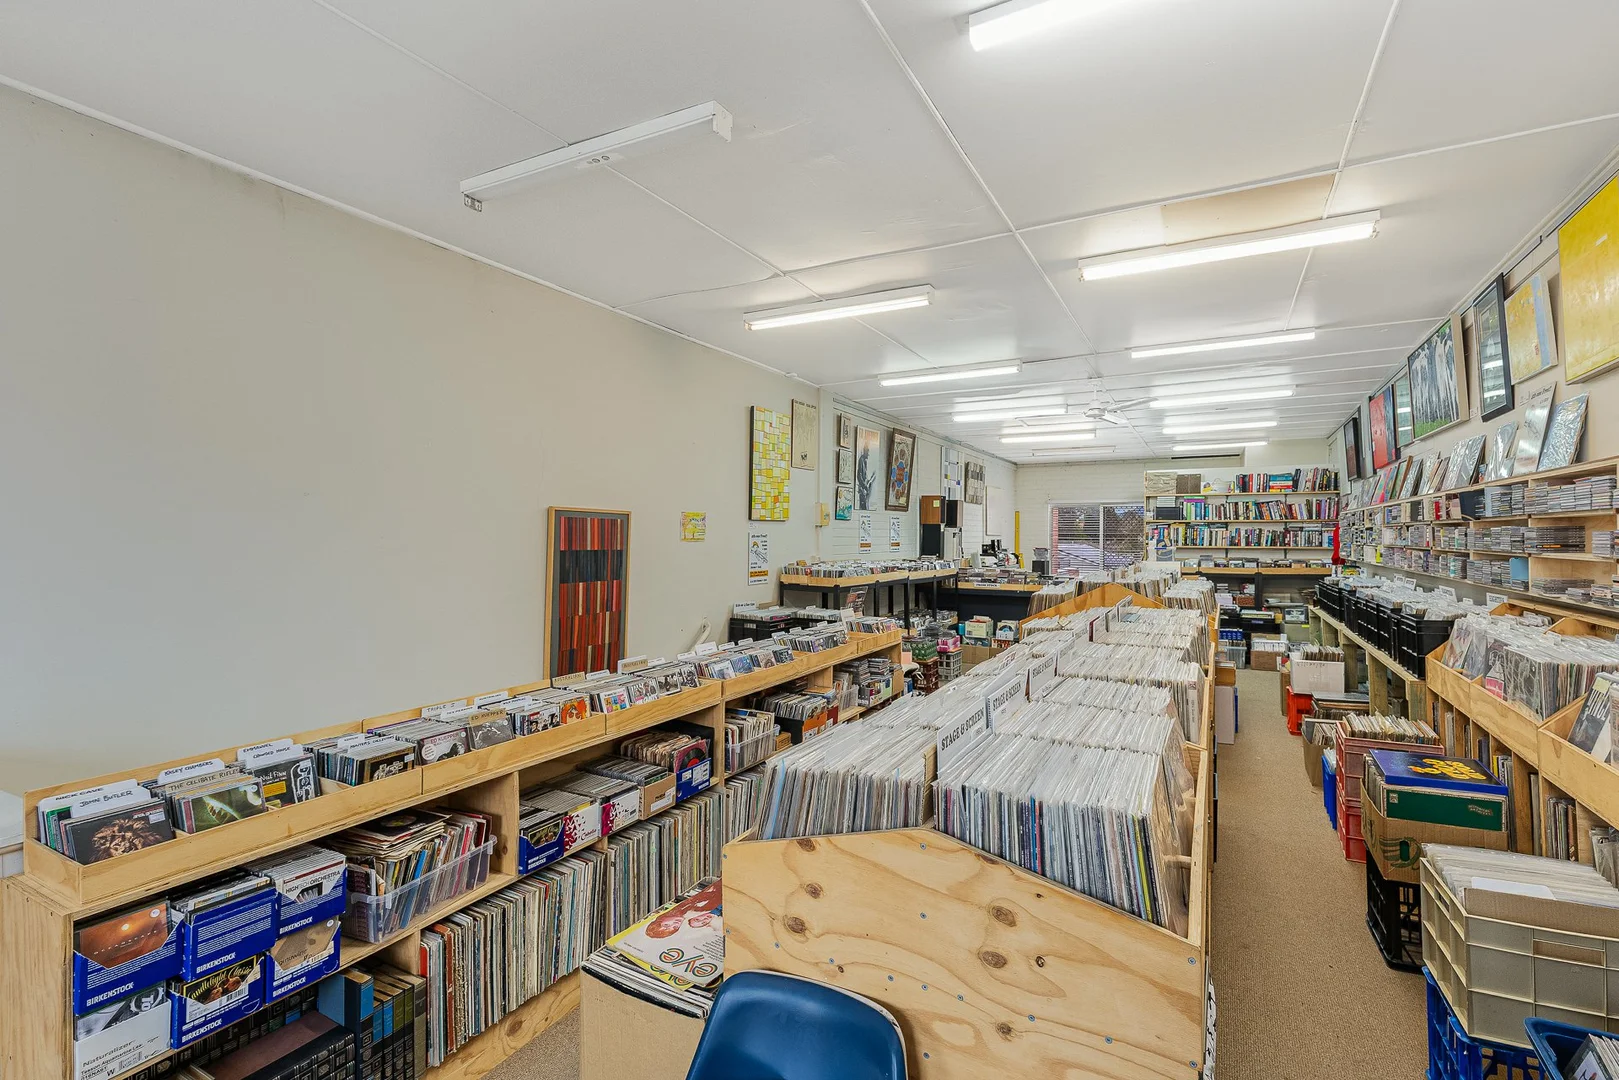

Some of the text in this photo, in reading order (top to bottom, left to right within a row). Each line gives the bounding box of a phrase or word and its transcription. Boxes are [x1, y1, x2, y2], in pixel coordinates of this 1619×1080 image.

[992, 693, 1006, 711] STAGE
[1009, 681, 1022, 700] SCREEN
[941, 706, 985, 751] STAGE & SCREEN
[169, 782, 181, 791] THE
[185, 775, 216, 787] CELIBATE
[80, 789, 134, 808] JOHN BUTLER
[286, 884, 299, 894] HIGH
[310, 870, 341, 885] ORCHESTRA
[279, 916, 313, 935] BIRKENSTOCK
[196, 952, 236, 974] BIRKENSTOCK
[659, 948, 718, 978] eye
[86, 981, 135, 1007] BIRKENSTOCK
[272, 977, 307, 998] BIRKENSTOCK
[182, 1019, 223, 1043] BIRKENSTOCK
[82, 1039, 137, 1067] Naturalizer
[106, 1068, 116, 1077] W
